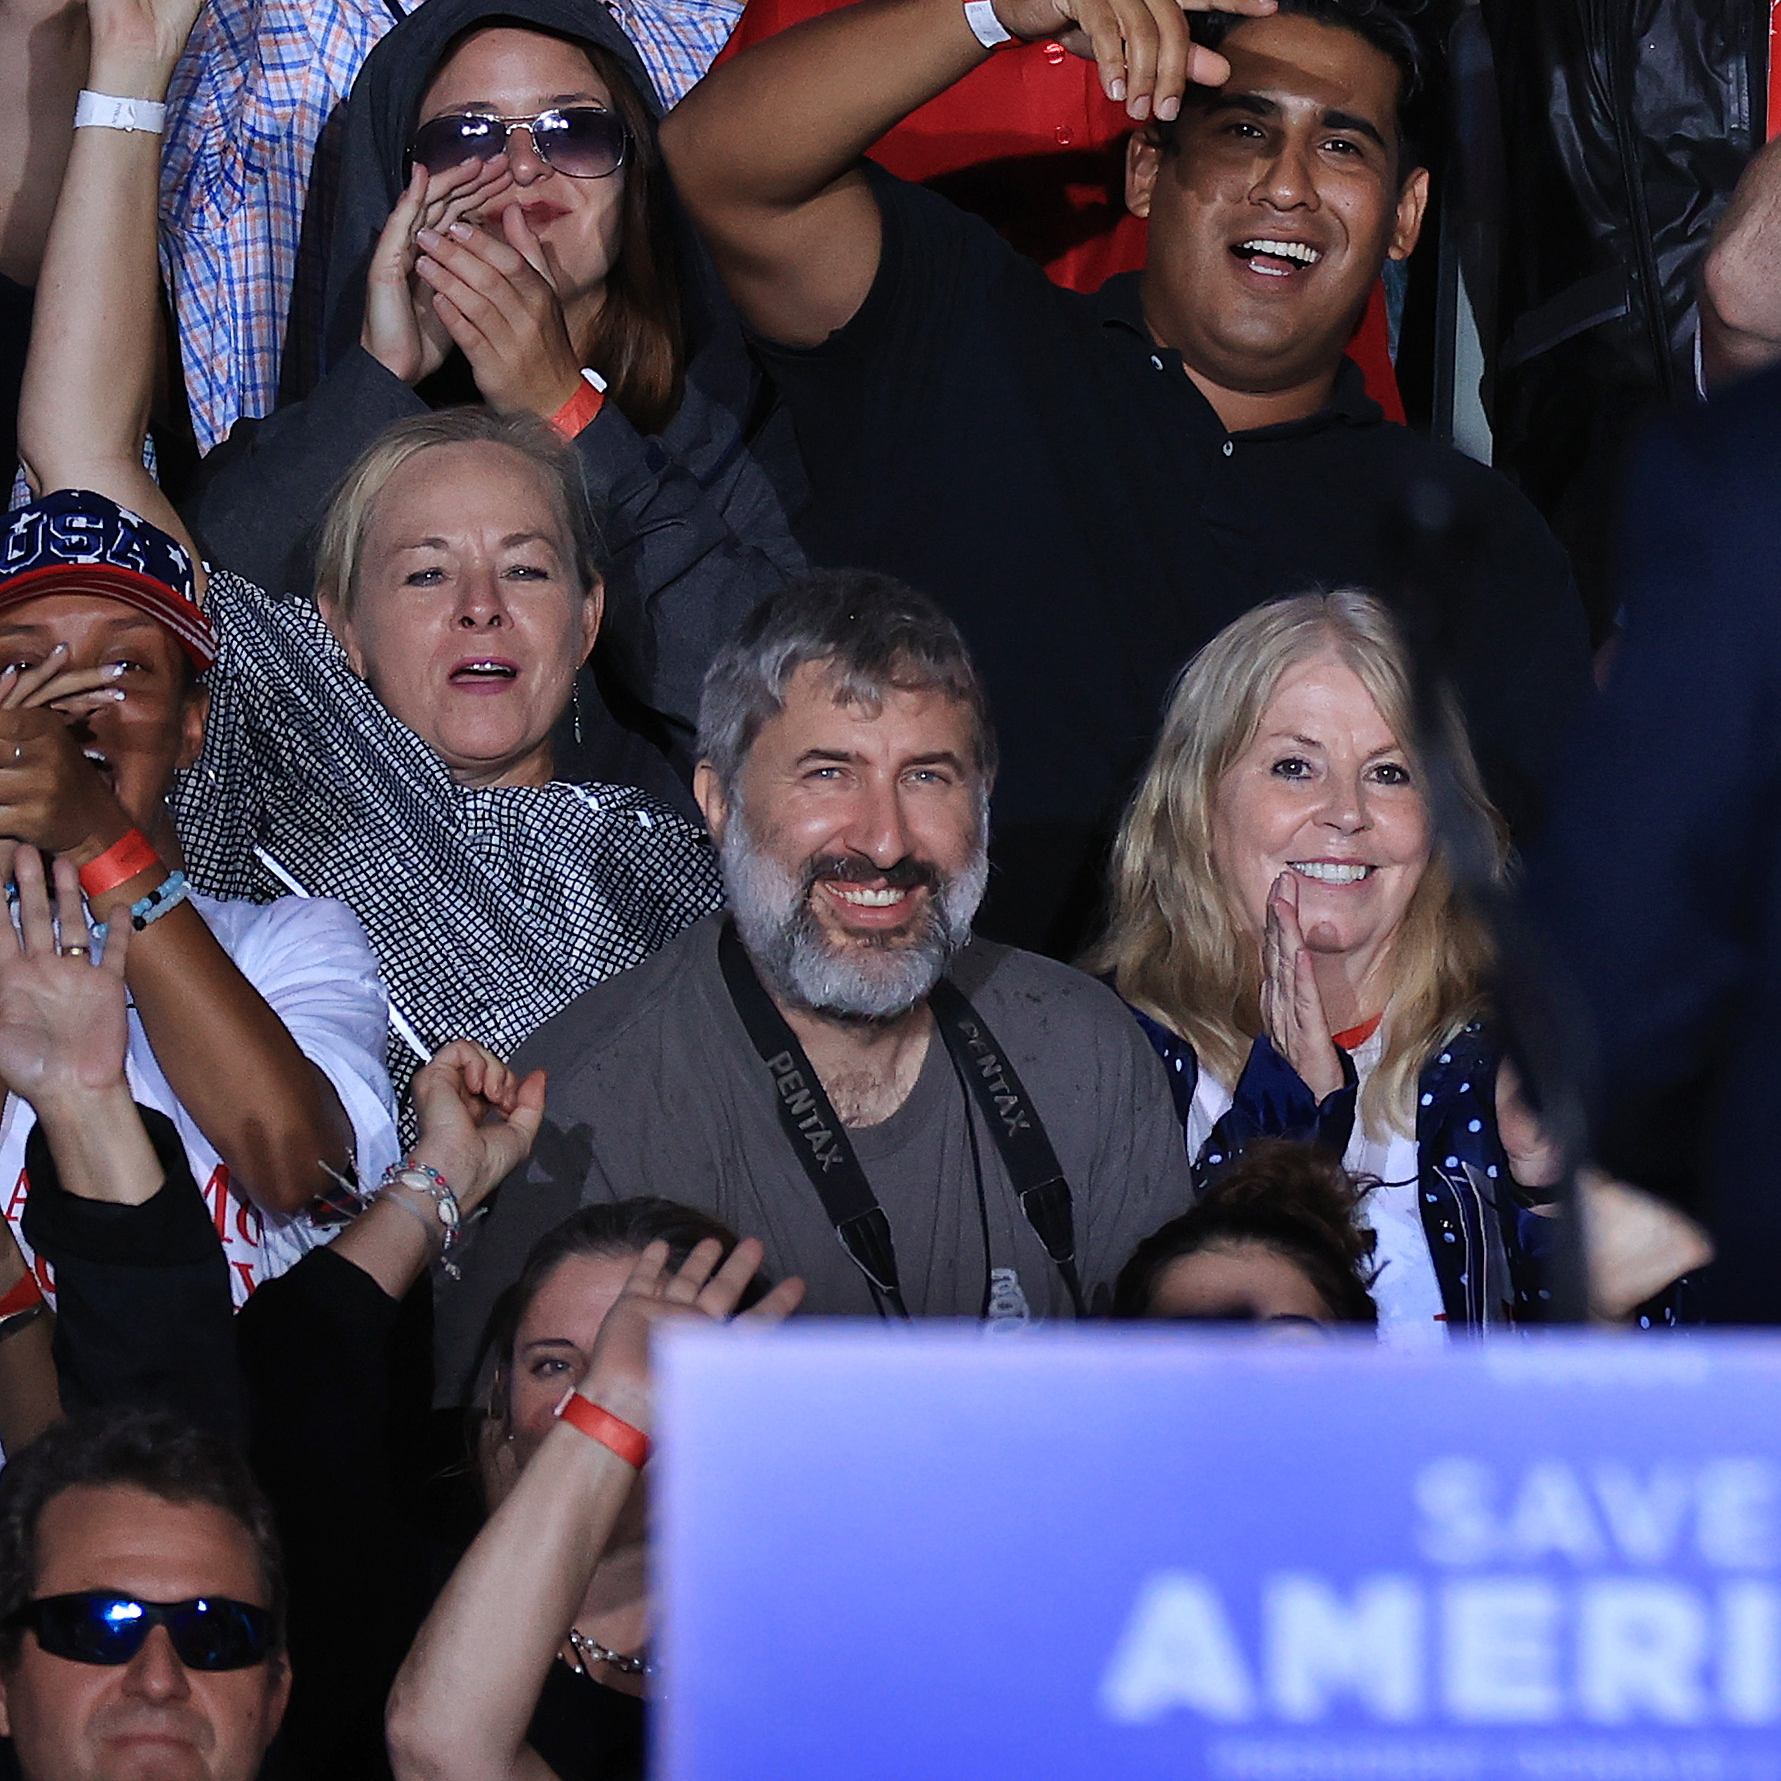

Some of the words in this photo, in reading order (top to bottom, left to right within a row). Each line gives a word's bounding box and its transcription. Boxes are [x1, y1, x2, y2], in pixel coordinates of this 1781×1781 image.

[0, 508, 151, 573] USA
[766, 1049, 844, 1174] PENTAX
[957, 1020, 1032, 1138] PENTAX
